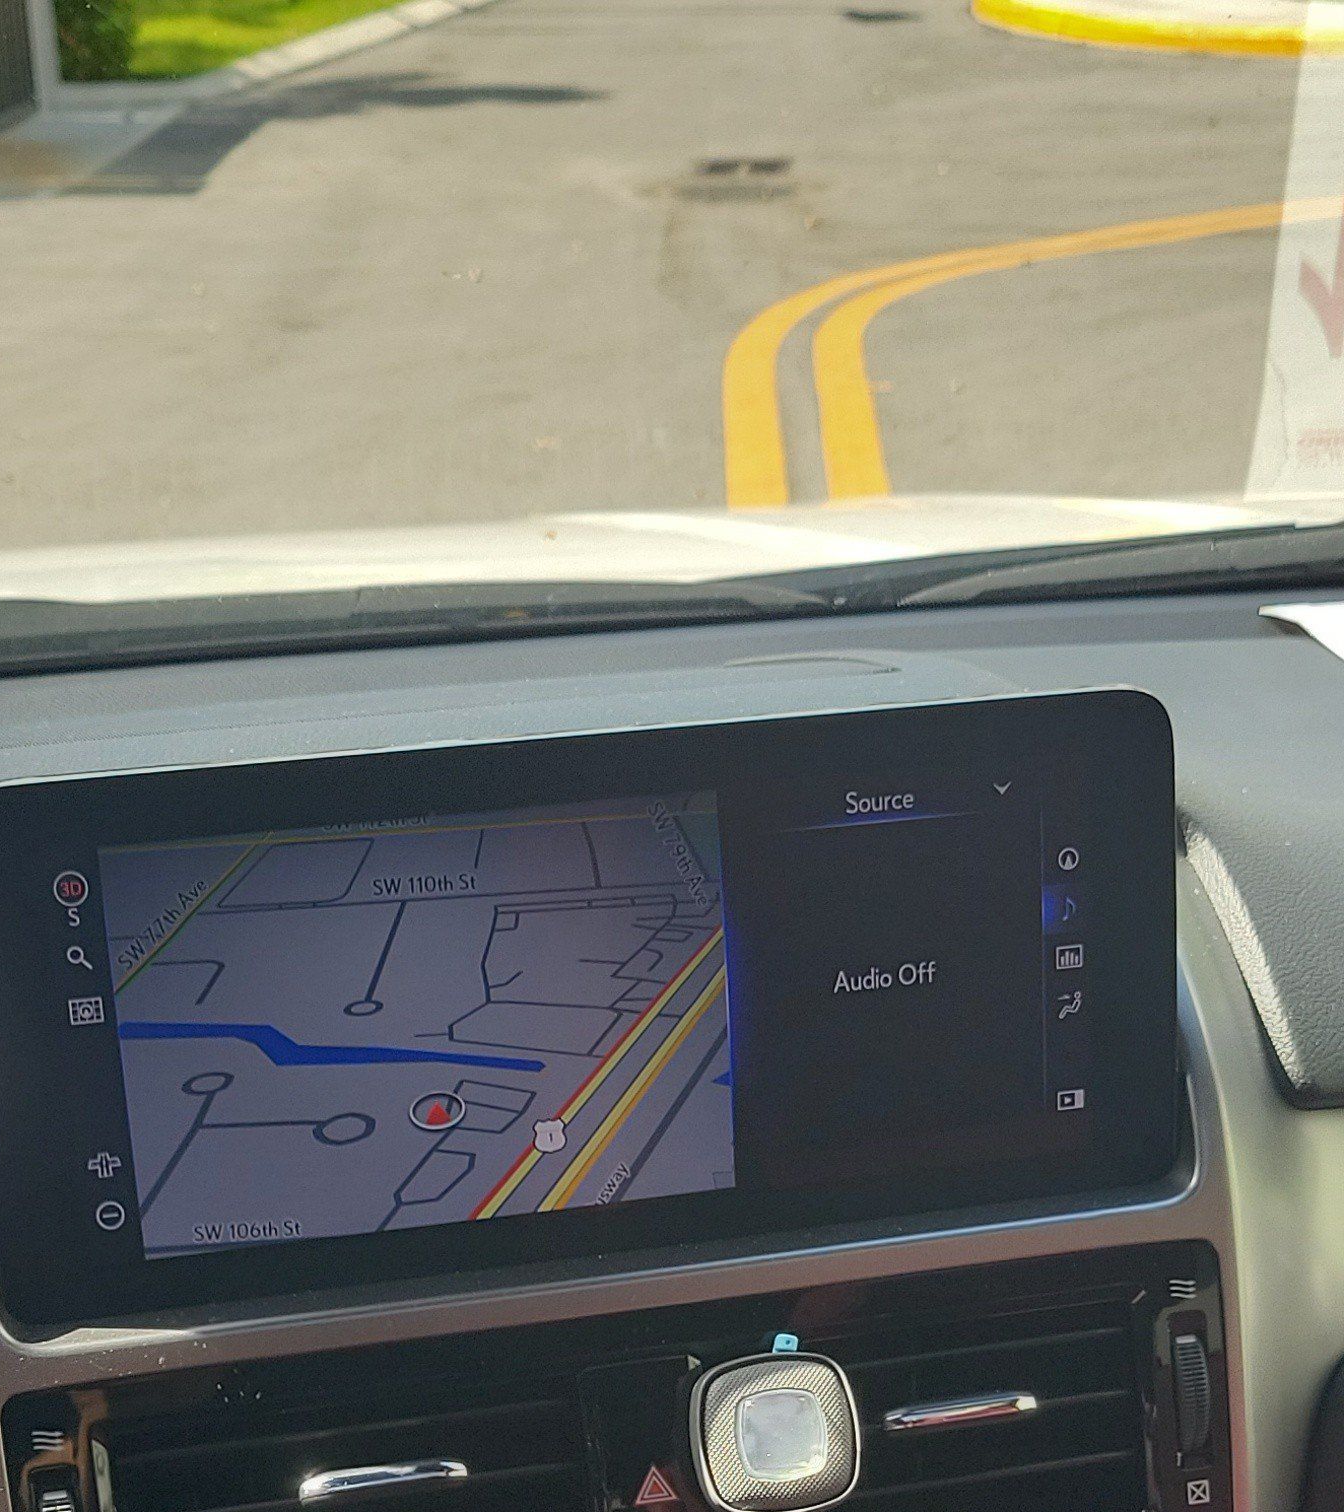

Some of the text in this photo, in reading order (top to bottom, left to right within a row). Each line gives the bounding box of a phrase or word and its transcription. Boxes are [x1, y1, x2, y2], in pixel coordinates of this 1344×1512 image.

[844, 791, 915, 815] Source
[59, 881, 82, 897] 3D
[372, 873, 476, 896] SW 110th St
[117, 880, 207, 970] SW 77th Ave
[833, 961, 936, 994] Audio Off
[193, 1219, 301, 1242] SW 106th St
